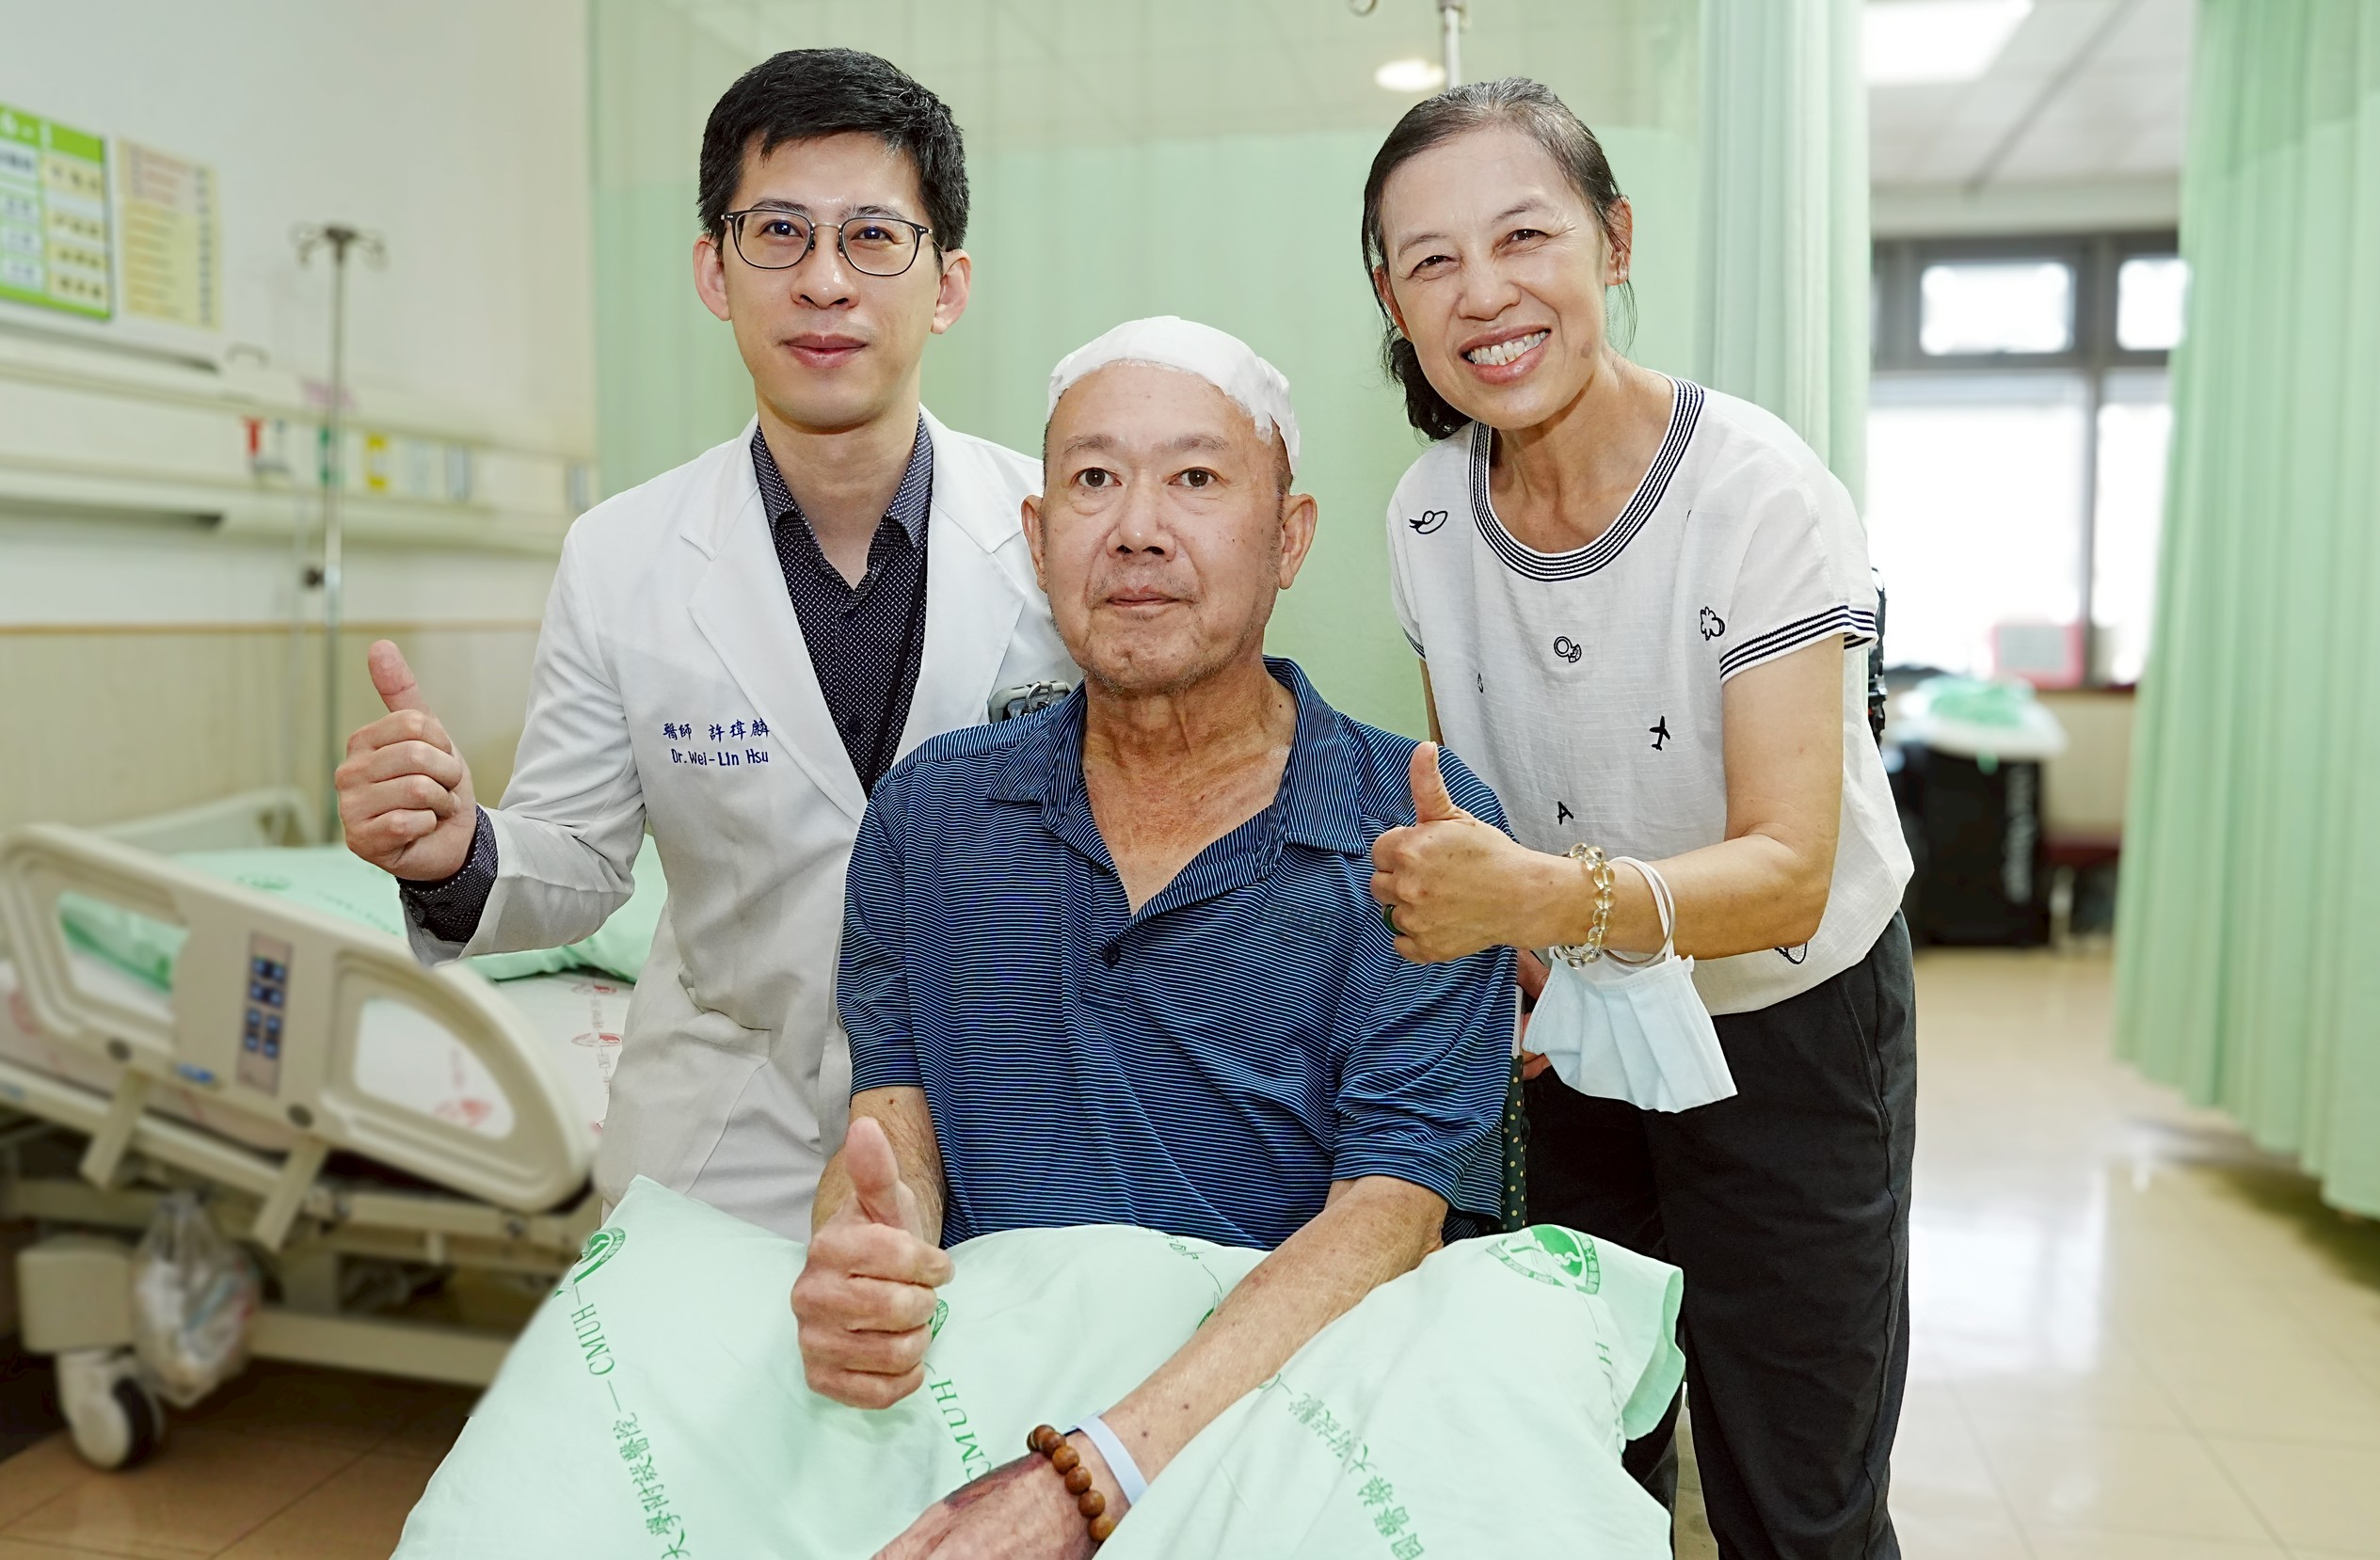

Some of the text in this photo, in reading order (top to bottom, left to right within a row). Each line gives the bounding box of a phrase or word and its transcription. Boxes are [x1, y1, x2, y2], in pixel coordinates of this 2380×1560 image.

[663, 723, 693, 741] 醫師
[745, 748, 769, 764] Hsu
[570, 1303, 615, 1376] CMUH
